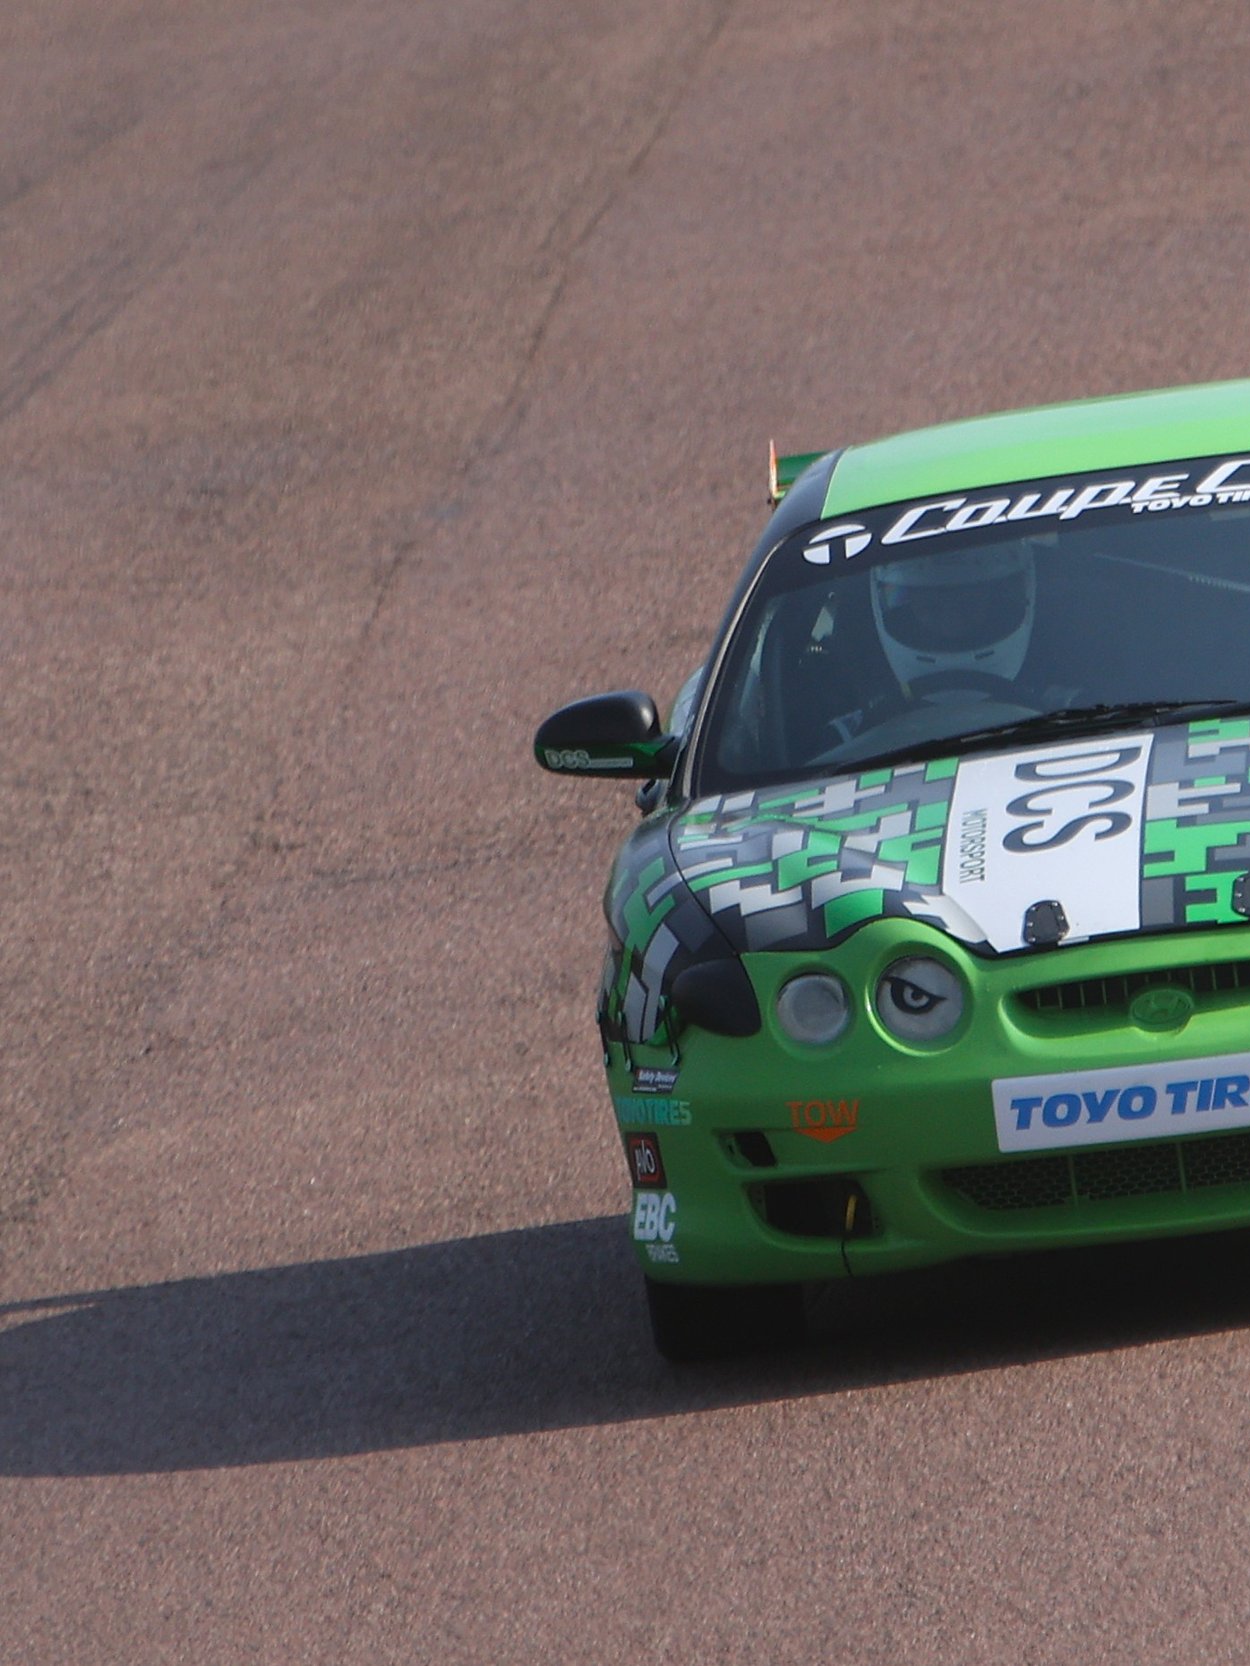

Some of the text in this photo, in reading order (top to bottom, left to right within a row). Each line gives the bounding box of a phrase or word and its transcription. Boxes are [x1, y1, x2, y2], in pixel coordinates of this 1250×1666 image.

[1131, 493, 1213, 514] TOYO
[1002, 746, 1143, 853] DCS
[959, 808, 987, 884] MOTORSPORT
[785, 1100, 860, 1128] TOW
[1010, 1085, 1160, 1131] TOYO
[633, 1192, 677, 1242] EBC
